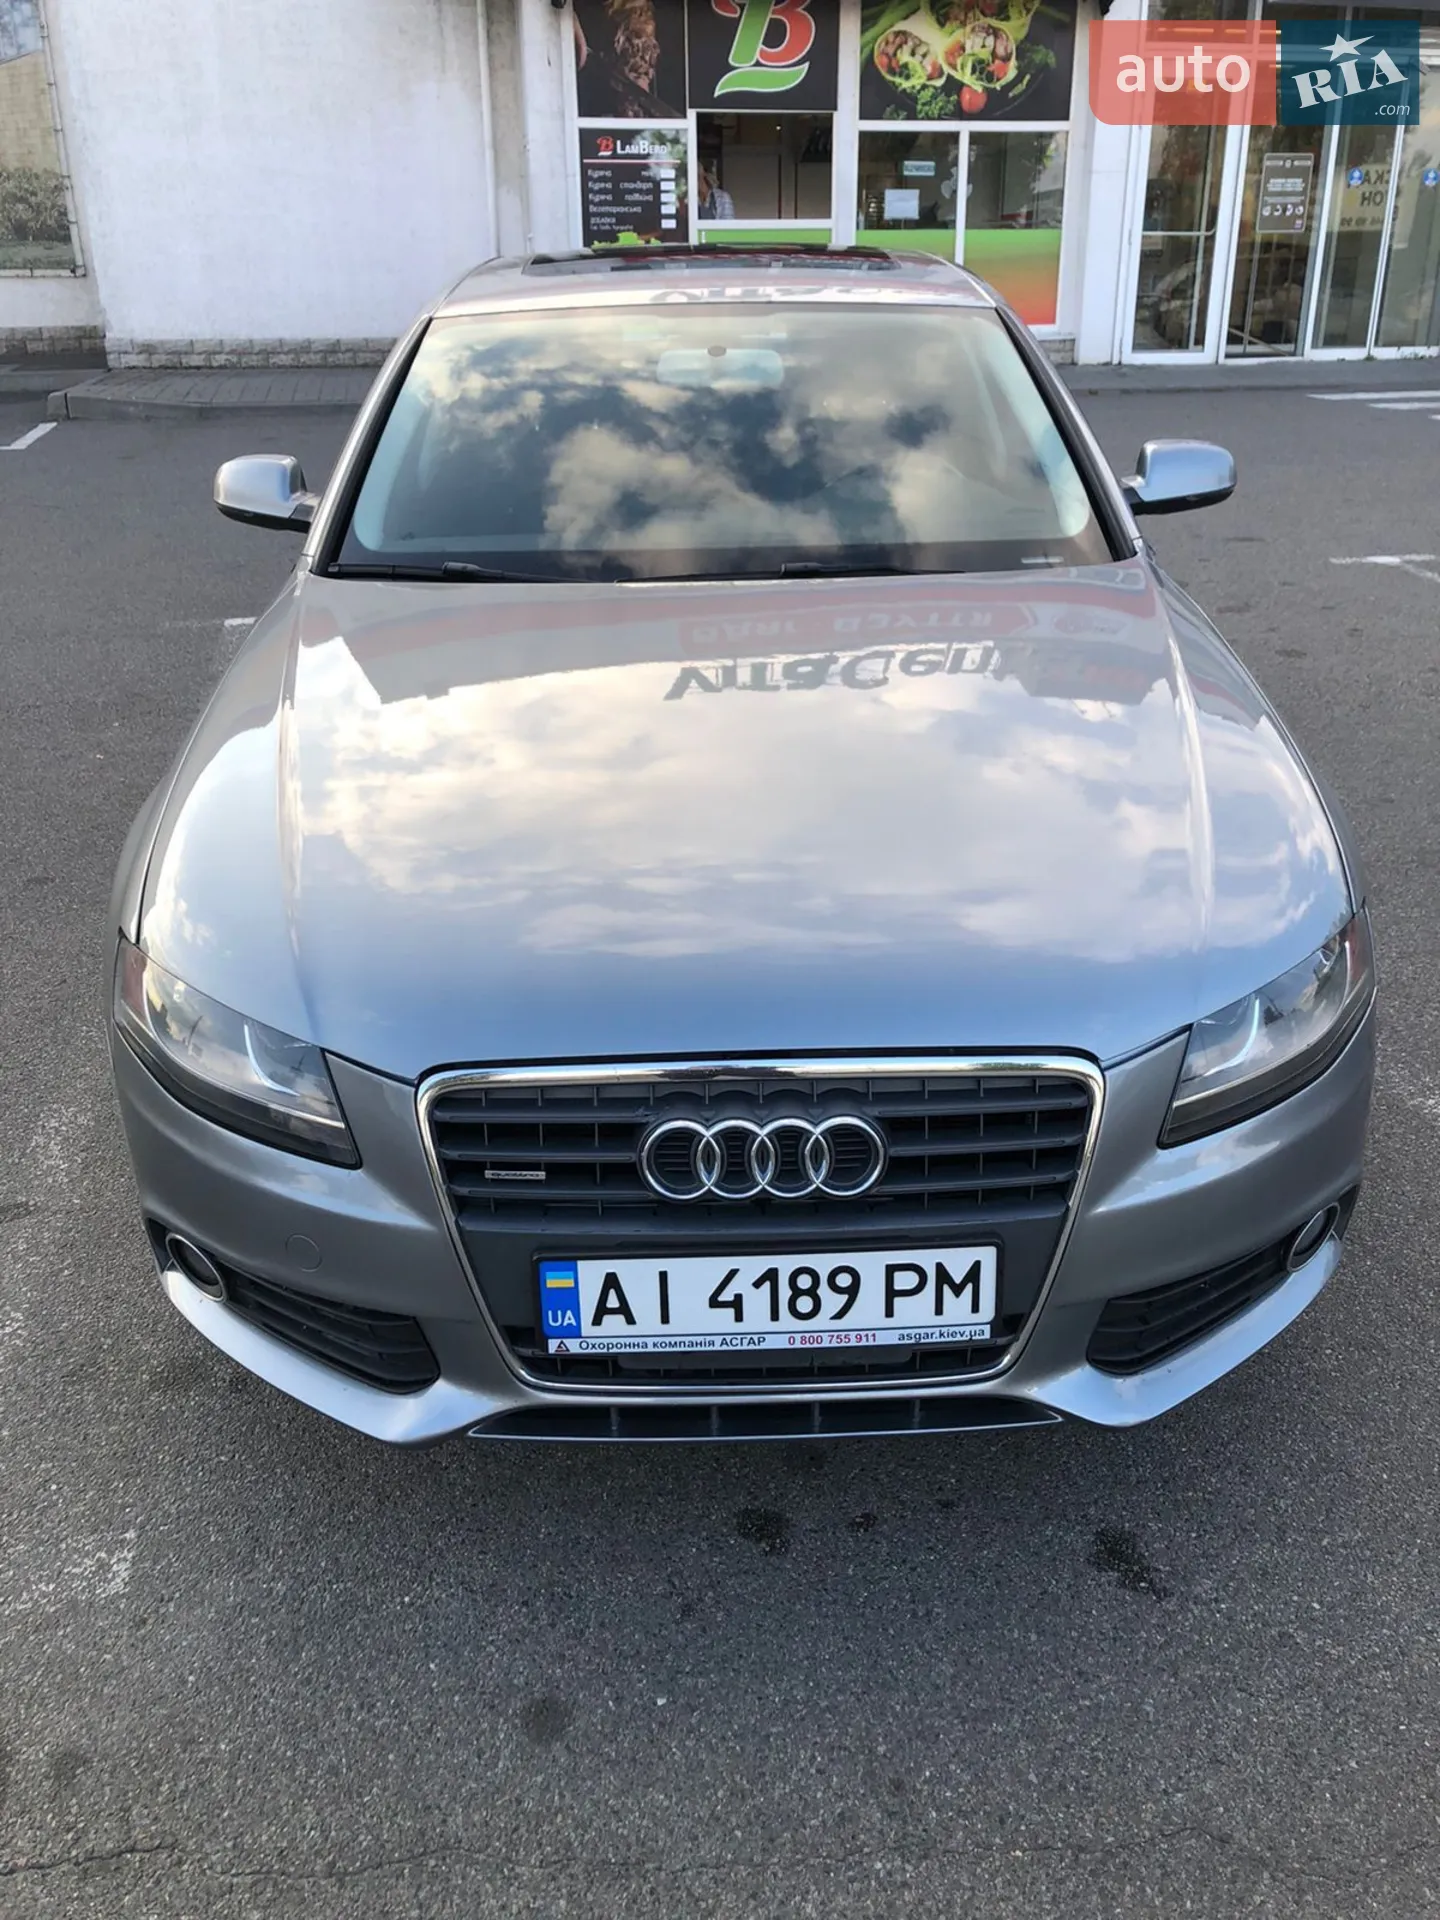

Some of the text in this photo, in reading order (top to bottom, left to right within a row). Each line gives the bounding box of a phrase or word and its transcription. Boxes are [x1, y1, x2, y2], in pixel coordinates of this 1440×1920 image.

[591, 1260, 982, 1326] AI 4189 PM
[547, 1310, 577, 1326] UA
[578, 1327, 985, 1351] Охоронна компанія АСГАР 0 800 755 911 asgar.kiev.ua
